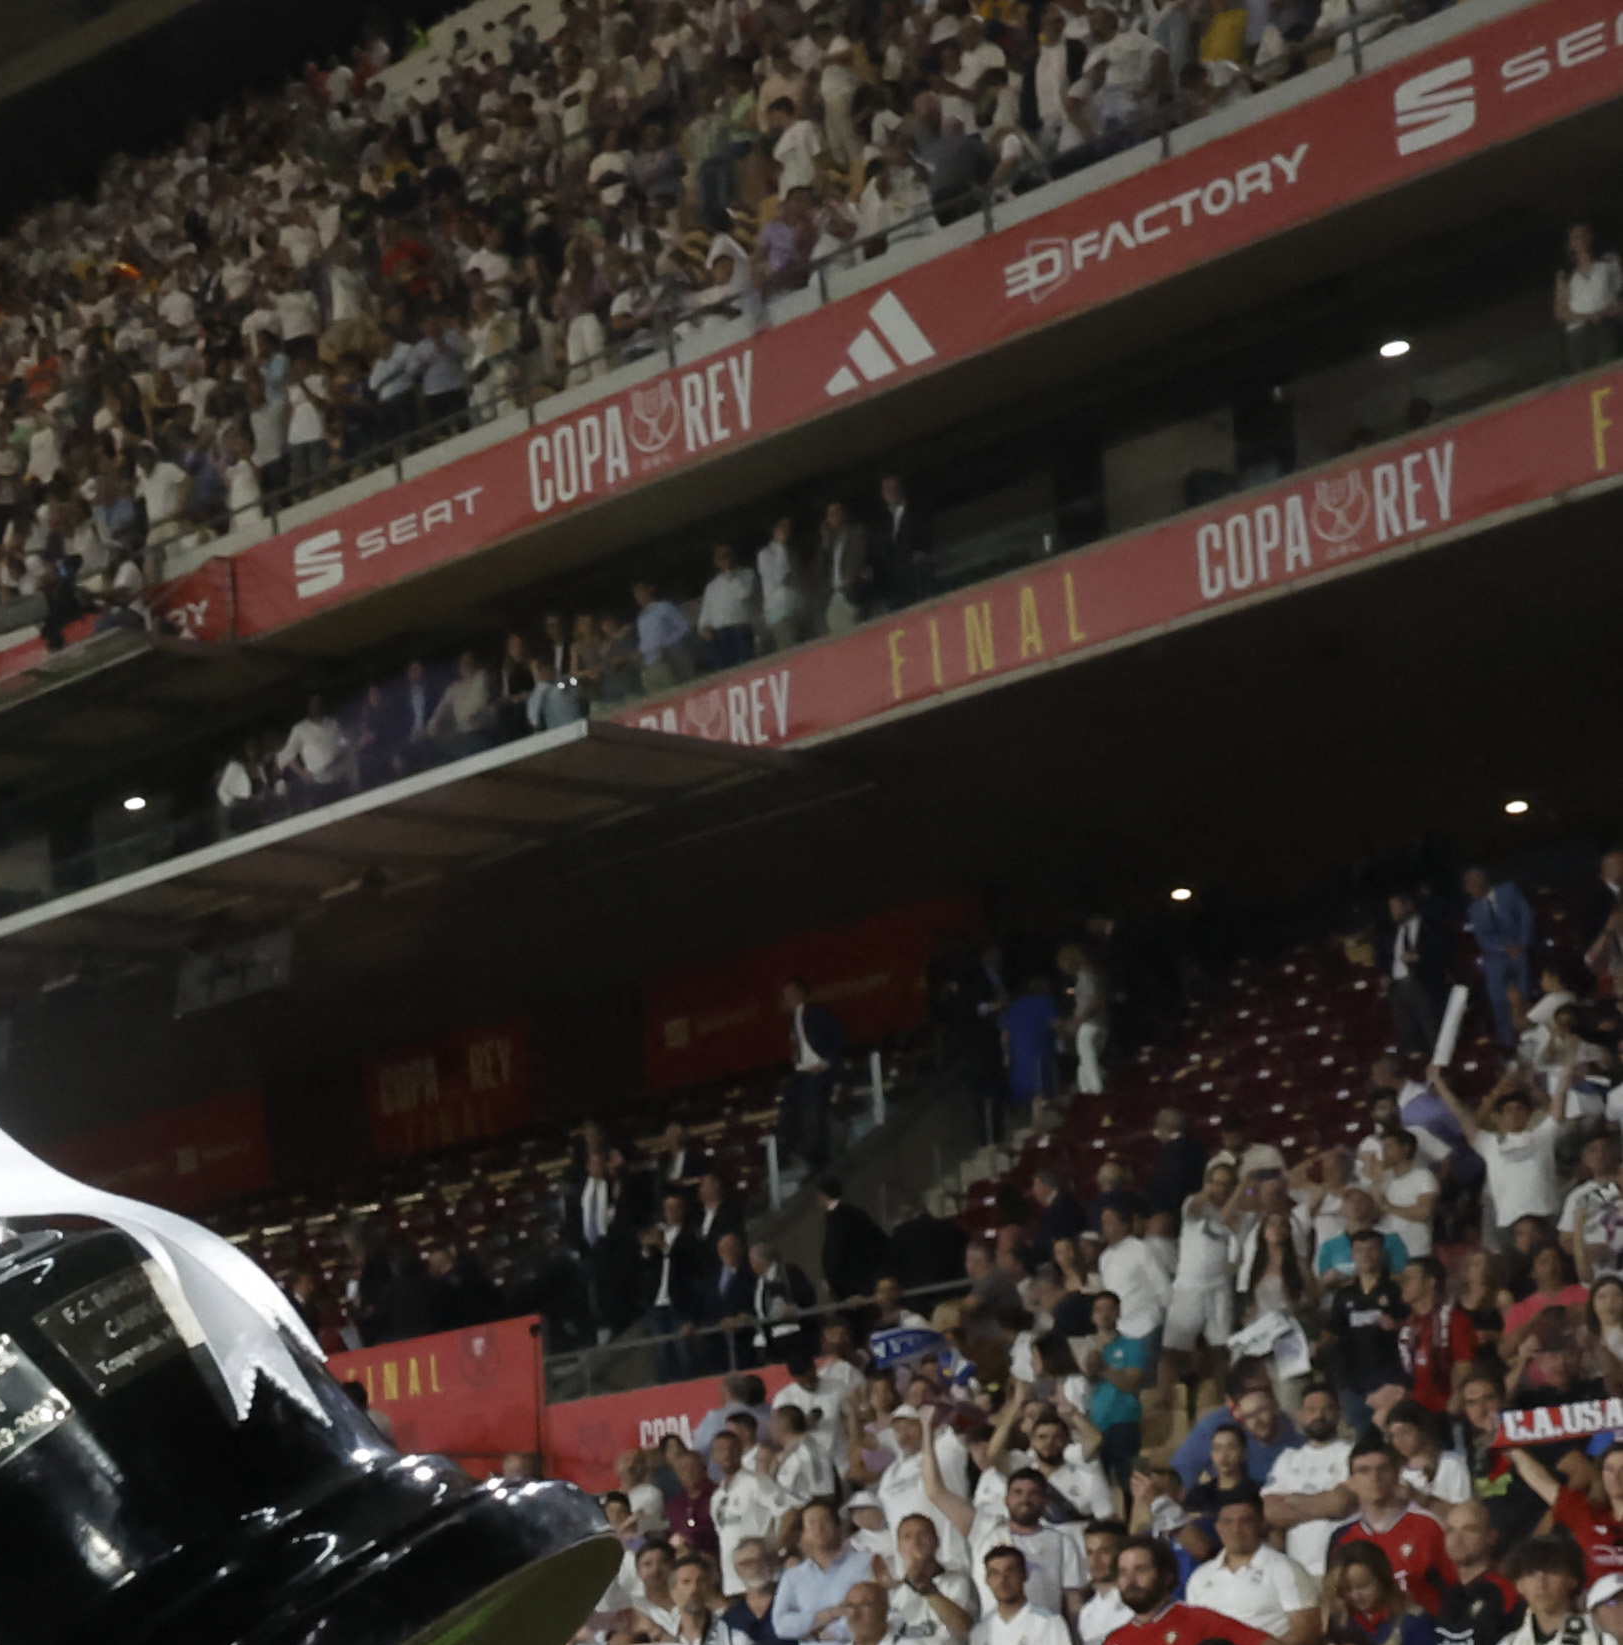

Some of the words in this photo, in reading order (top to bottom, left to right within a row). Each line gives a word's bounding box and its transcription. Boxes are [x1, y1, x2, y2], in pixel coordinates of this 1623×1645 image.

[1500, 14, 1623, 94] SE
[528, 405, 630, 513] COPA
[681, 350, 754, 452] REY
[356, 485, 485, 560] SEAT
[1197, 494, 1313, 600] COPA
[1373, 441, 1456, 542] REY
[888, 571, 1087, 699] FINAL
[347, 1354, 442, 1403] INAL
